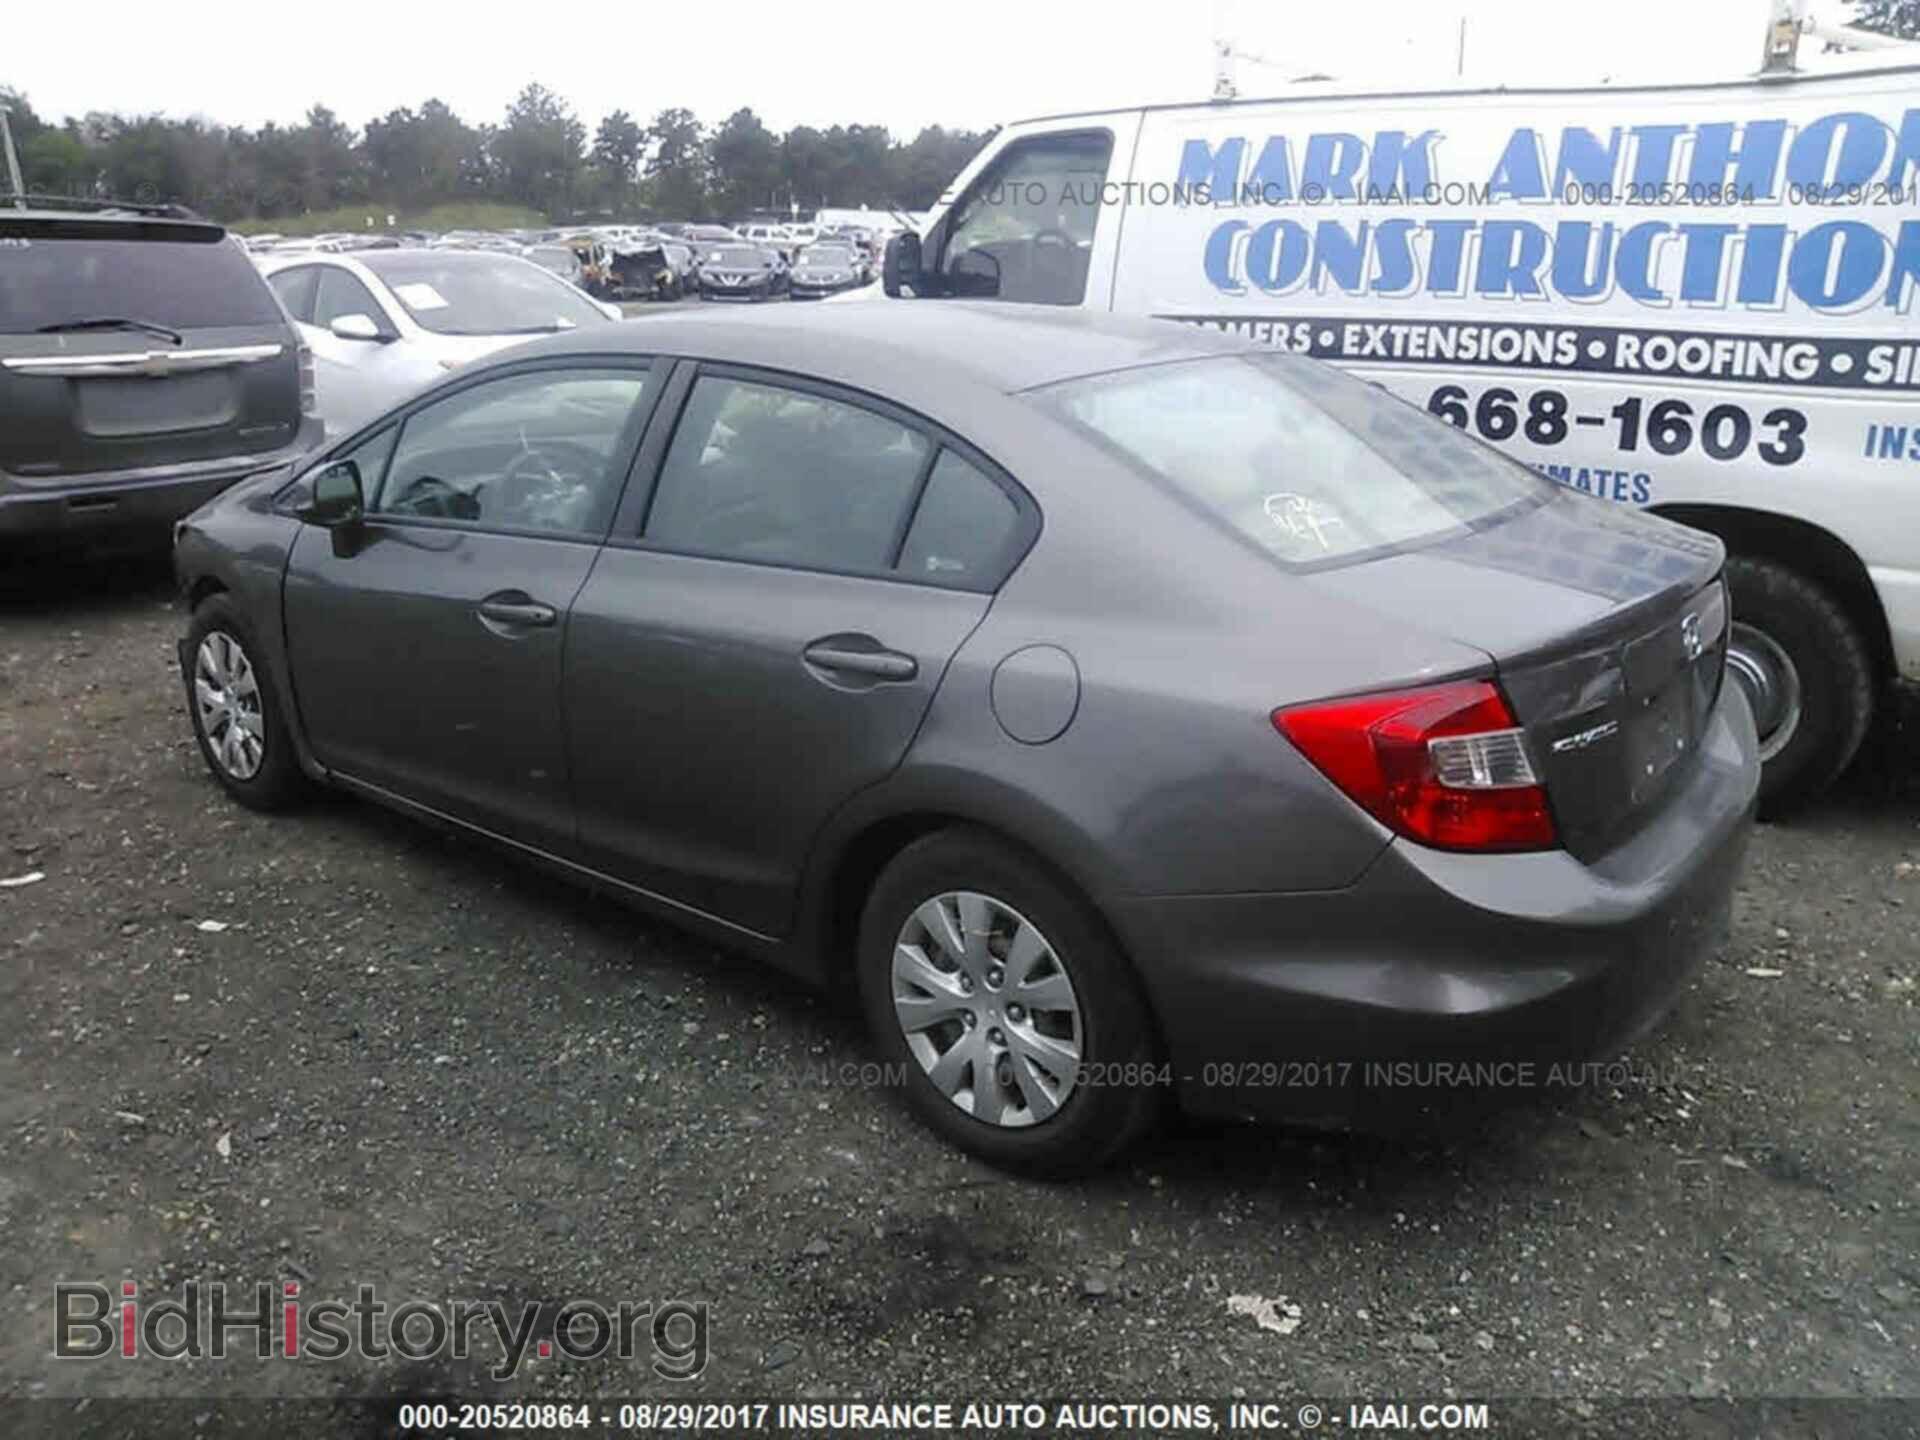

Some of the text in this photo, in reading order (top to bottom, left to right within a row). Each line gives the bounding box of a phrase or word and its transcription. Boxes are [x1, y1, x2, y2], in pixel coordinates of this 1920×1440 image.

[1178, 130, 1446, 207] MARK
[1342, 324, 1578, 365] EXTENSIONS
[1615, 335, 1820, 382] ROOFING
[1428, 384, 1808, 467] 668-1603
[1537, 463, 1652, 504] MATES
